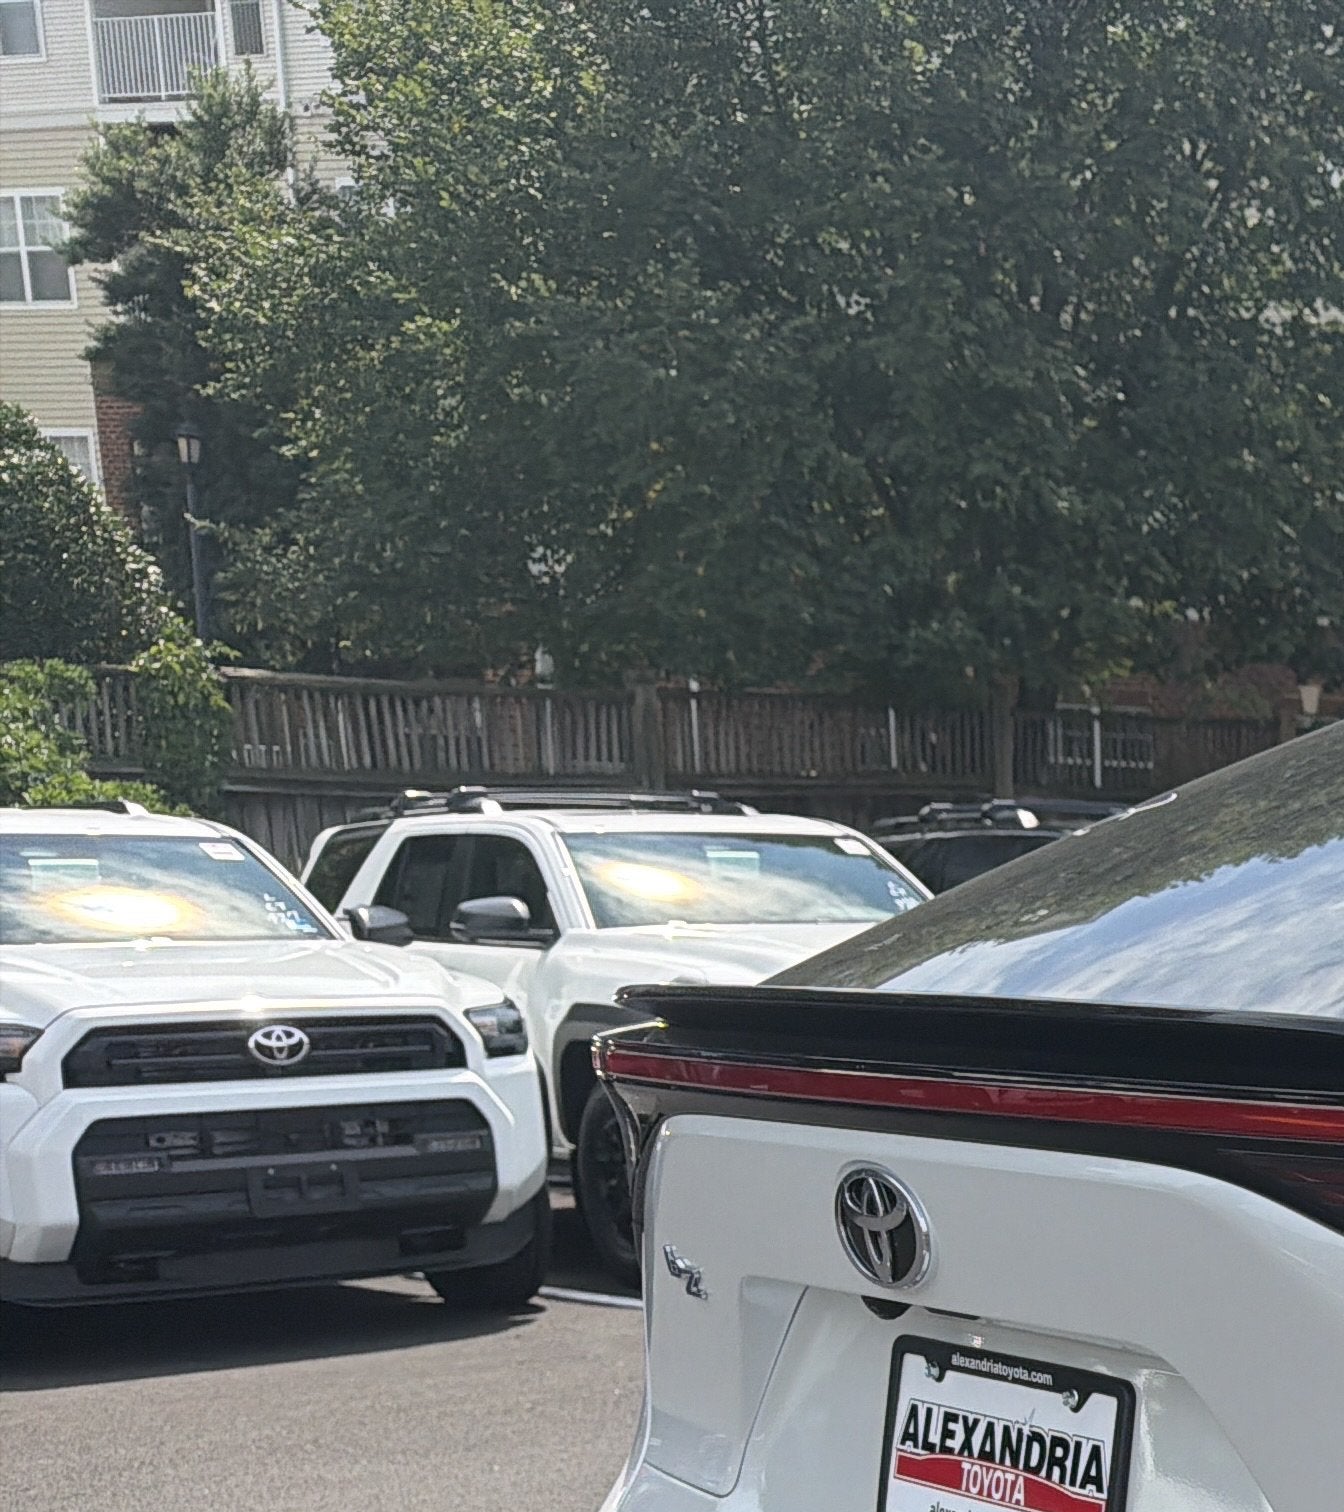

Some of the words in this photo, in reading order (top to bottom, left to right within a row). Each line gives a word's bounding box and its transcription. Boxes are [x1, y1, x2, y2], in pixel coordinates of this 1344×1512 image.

[951, 1351, 1053, 1386] alexandriatoyota.com
[899, 1401, 1106, 1496] ALEXANDRIA
[961, 1461, 1025, 1507] TOYOTA
